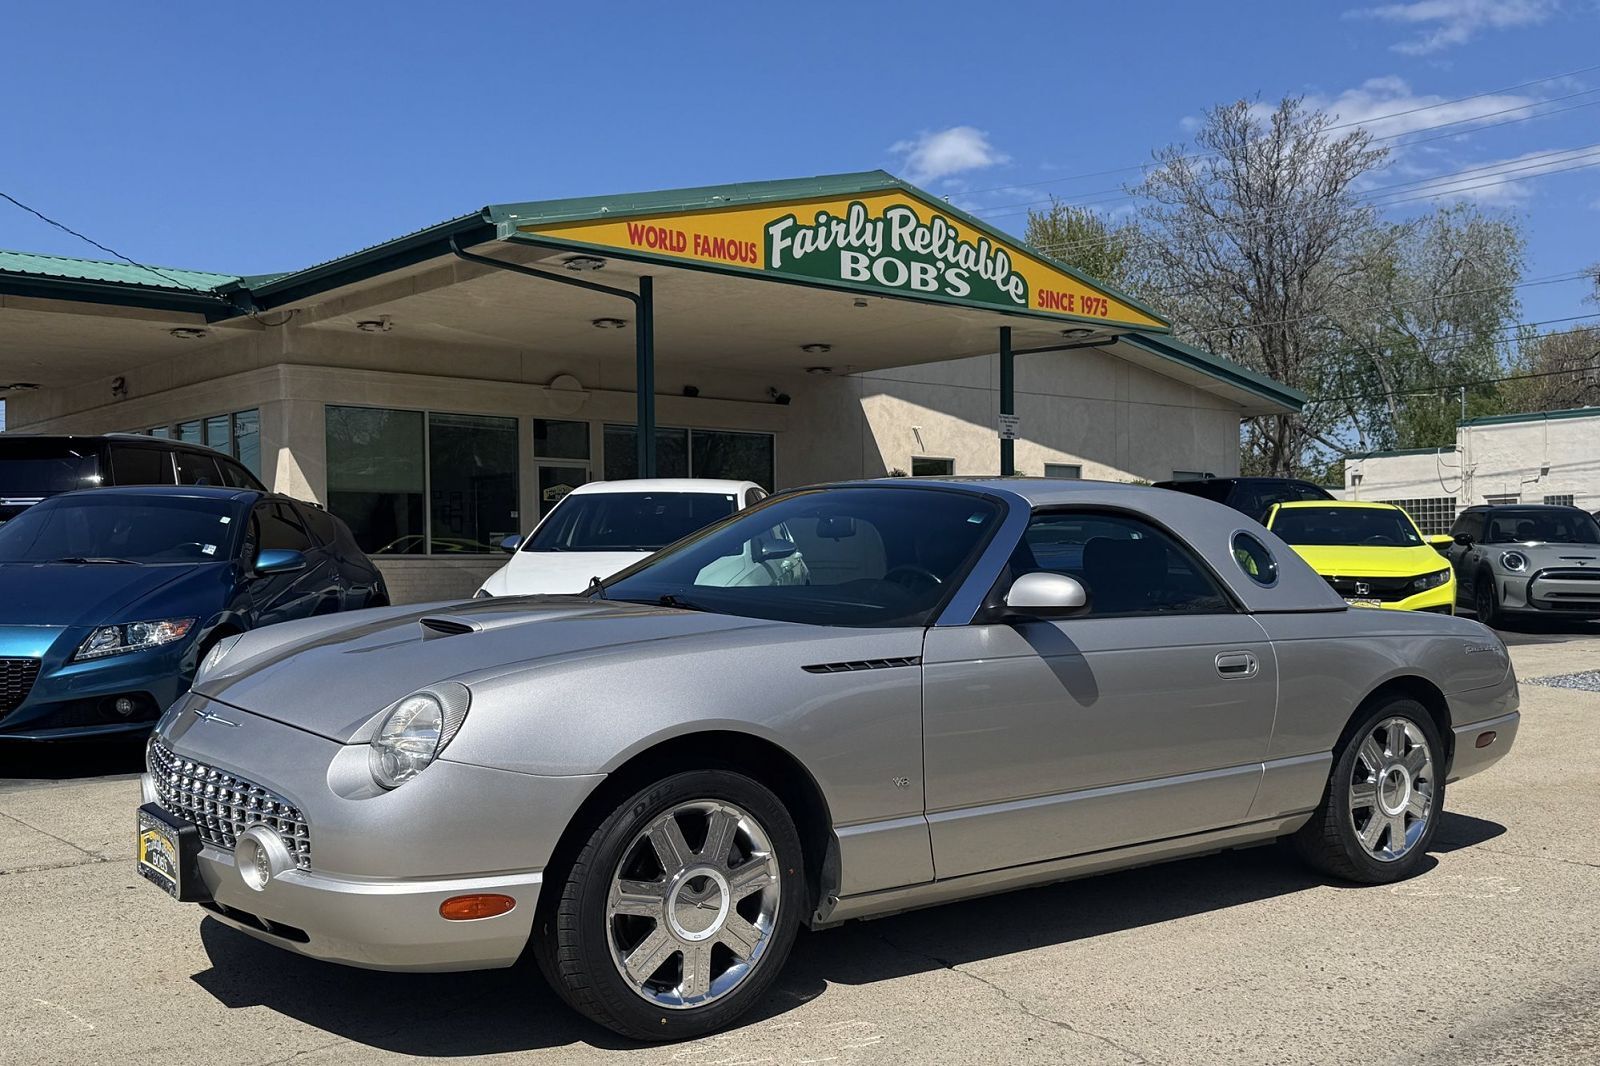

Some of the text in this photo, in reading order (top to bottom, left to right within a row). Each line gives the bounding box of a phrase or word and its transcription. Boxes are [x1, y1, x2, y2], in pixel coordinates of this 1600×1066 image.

[627, 222, 757, 264] WORLD FAMOUS
[768, 204, 1026, 304] Fairly Reliable
[840, 249, 971, 297] BOB'S
[1037, 288, 1108, 317] SINCE 1975
